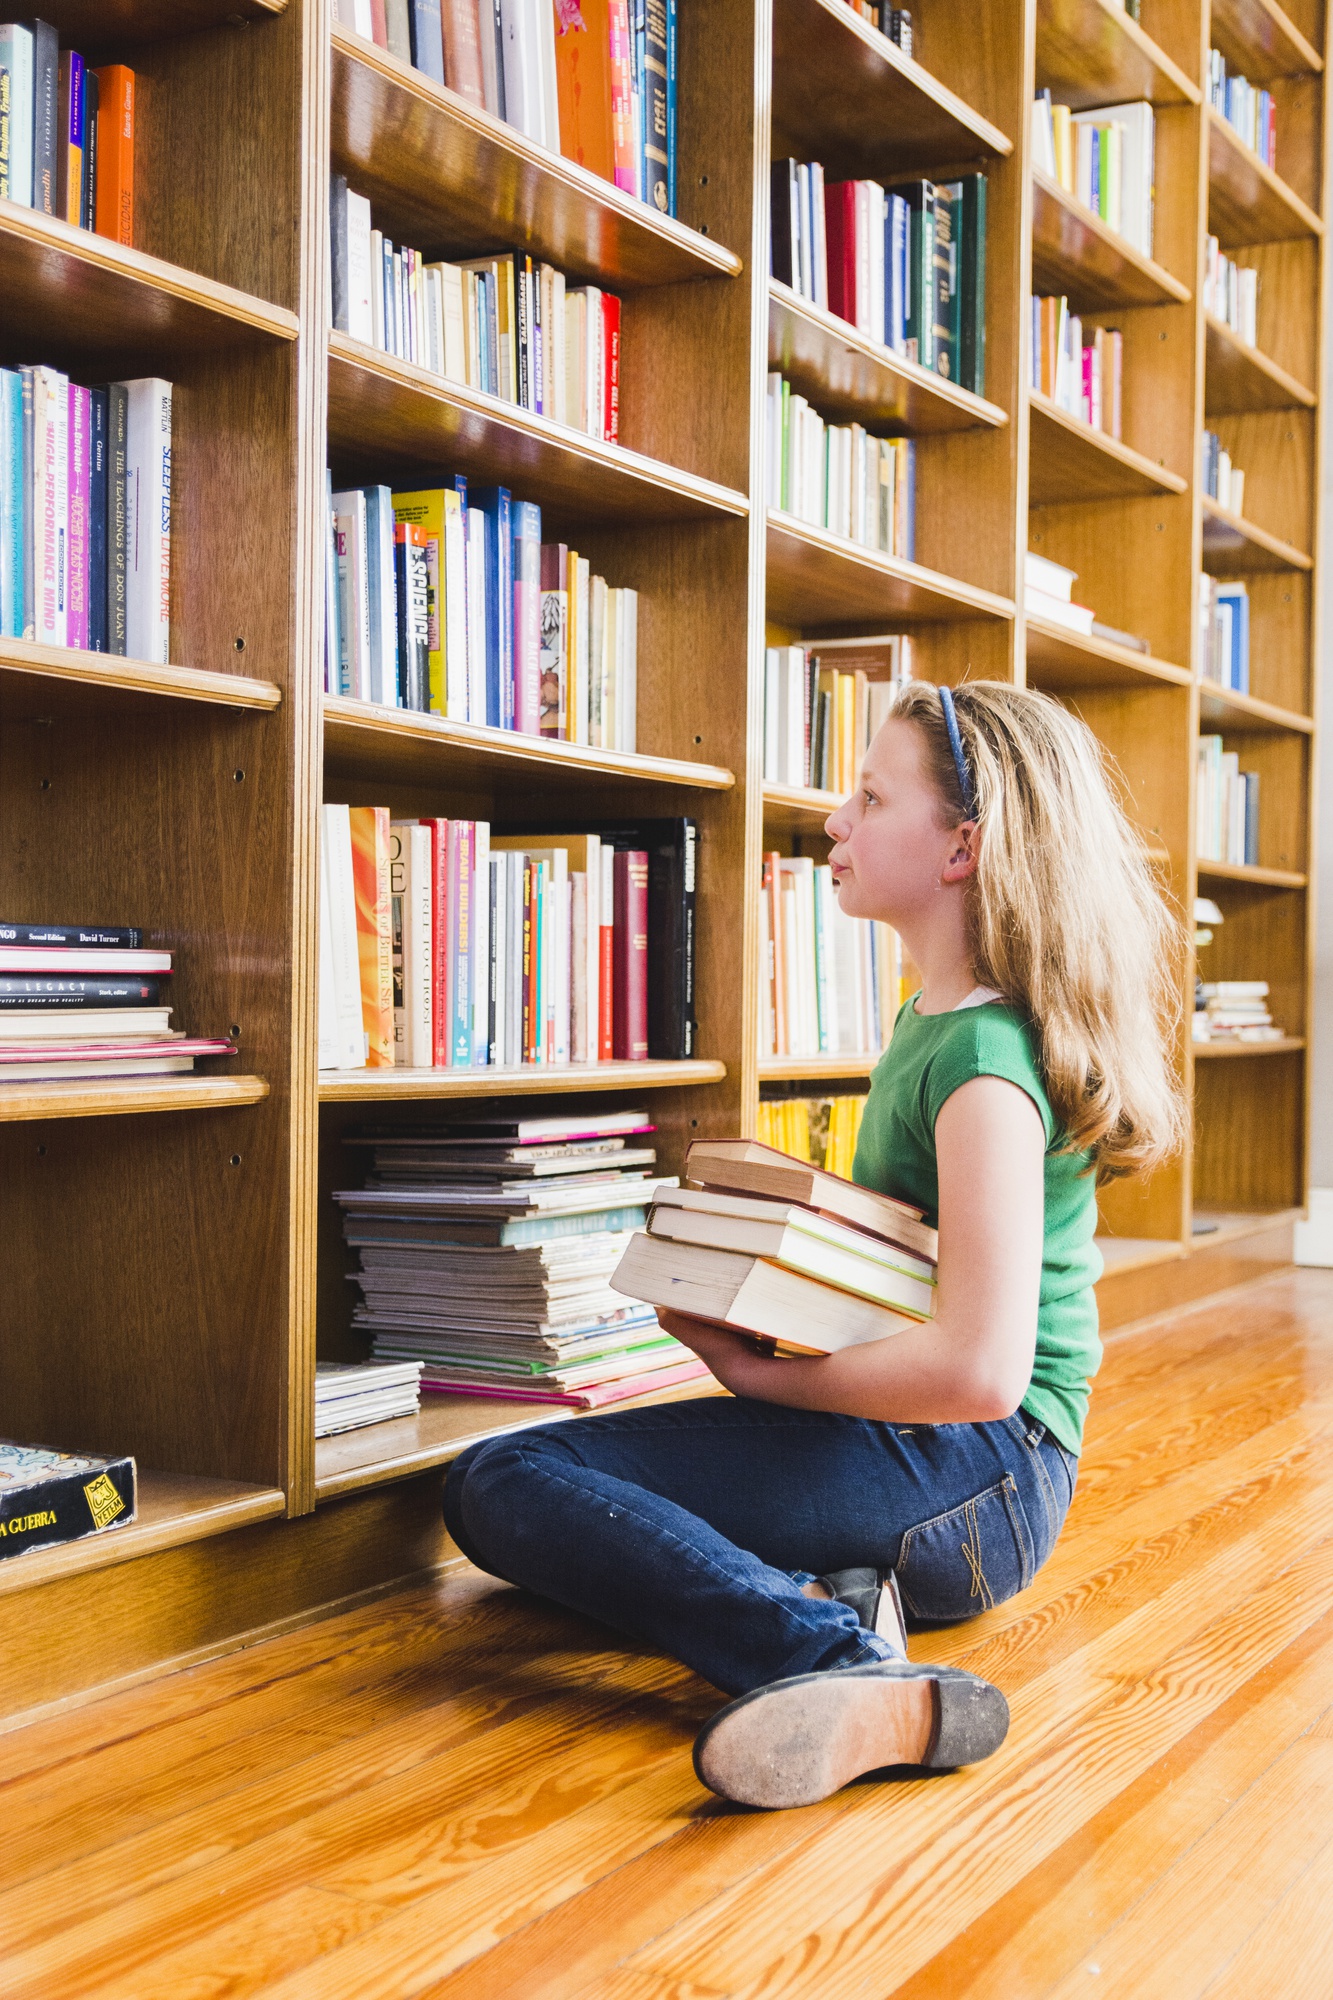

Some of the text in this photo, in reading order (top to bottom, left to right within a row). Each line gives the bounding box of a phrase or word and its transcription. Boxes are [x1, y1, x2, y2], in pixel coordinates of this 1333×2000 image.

[0, 74, 10, 113] Franklin
[0, 116, 10, 160] Benjamin
[123, 112, 131, 139] Eduardo
[0, 163, 8, 174] Of
[42, 168, 52, 214] gandhi
[120, 188, 131, 247] ELICIDADE
[534, 330, 542, 402] ANARCHISM
[116, 450, 126, 475] THE
[162, 445, 171, 496] SLEEP
[44, 427, 55, 584] HIGH-PERFORMANCE
[70, 494, 84, 537] NOCHE
[116, 479, 125, 549] TEACHINGS
[71, 537, 84, 569] TRAS
[116, 552, 125, 569] OF
[160, 536, 171, 575] LIVE
[44, 587, 55, 631] MIND
[71, 569, 84, 613] NOCHE
[116, 574, 125, 602] DON
[160, 576, 170, 623] MORE
[115, 606, 125, 640] JUAN
[527, 641, 538, 671] BACH
[527, 673, 539, 717] READER
[459, 838, 469, 880] BRAIN
[379, 858, 389, 914] SECRETS
[29, 933, 46, 941] Second
[47, 933, 66, 942] Edition
[79, 933, 97, 943] David
[98, 934, 120, 943] Turner
[459, 882, 469, 953] BUILDERS!
[380, 935, 391, 984] BETTER
[25, 982, 86, 991] LEGACY
[380, 987, 391, 1015] SEX
[9, 1510, 57, 1534] GUERRA
[97, 1498, 123, 1526] YETEM
